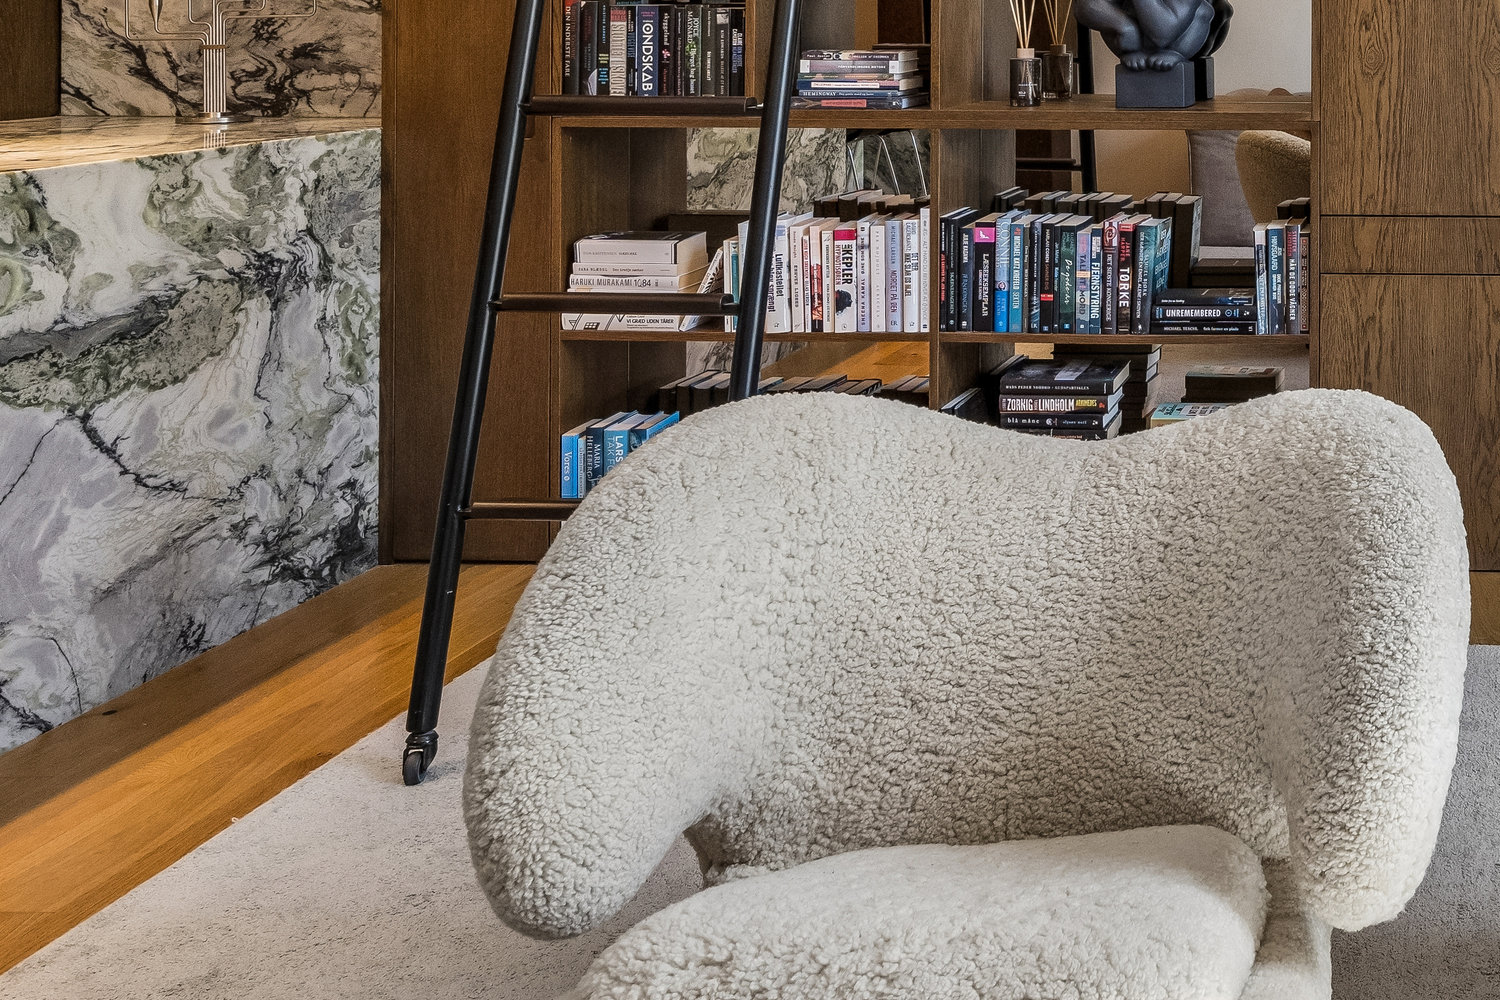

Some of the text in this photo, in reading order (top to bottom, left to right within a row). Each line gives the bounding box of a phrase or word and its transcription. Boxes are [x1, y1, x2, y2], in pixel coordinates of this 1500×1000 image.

[662, 12, 670, 46] skyggeland
[692, 17, 700, 38] JOYCE
[841, 250, 853, 285] KEPLER
[1013, 236, 1021, 290] MICHAEL KATZ KREFELD
[570, 278, 632, 287] HARUKI MURAKAMI
[1090, 262, 1101, 319] FJERNSTYRING
[1119, 267, 1130, 308] TØRKE
[1165, 309, 1221, 318] UNREMEMBERED
[1037, 398, 1075, 412] LINDHOLM
[585, 436, 594, 479] HELLEBERG
[593, 444, 601, 469] MARIA
[606, 436, 615, 457] TAK
[615, 436, 624, 463] LARS
